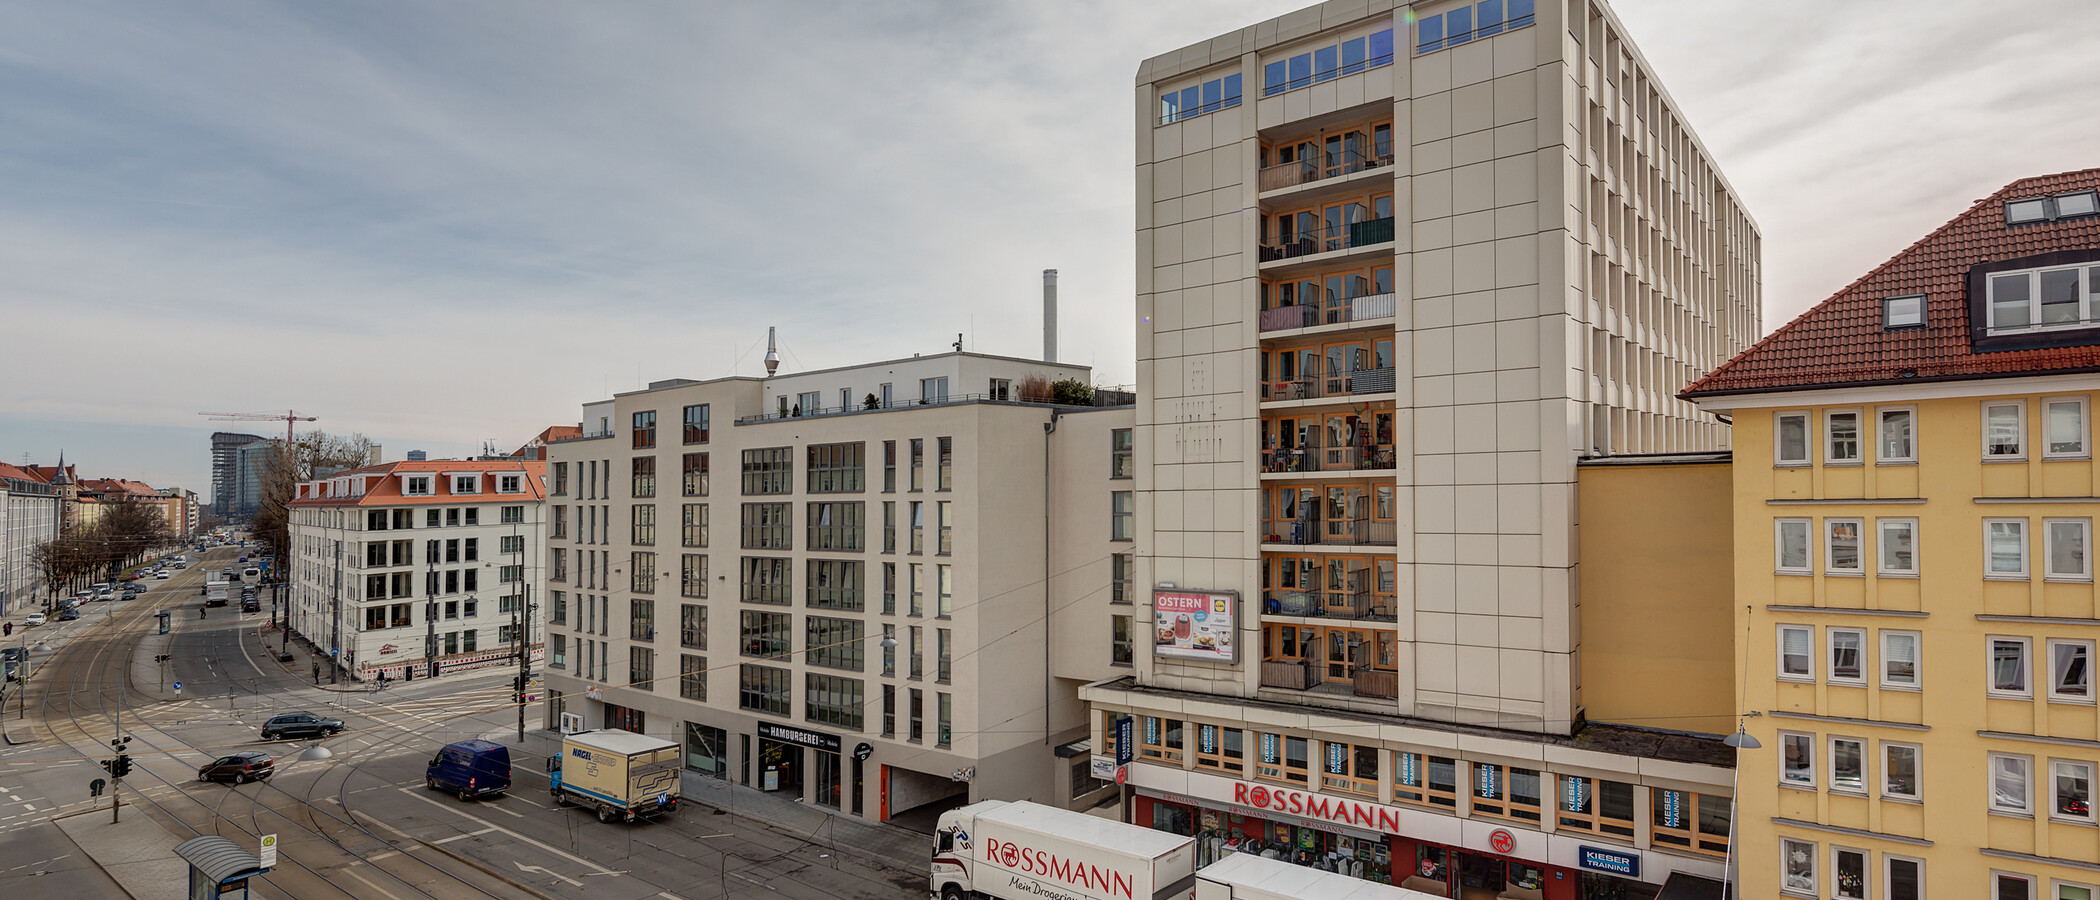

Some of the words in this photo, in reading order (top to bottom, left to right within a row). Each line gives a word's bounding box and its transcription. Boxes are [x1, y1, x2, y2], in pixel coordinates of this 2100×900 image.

[1158, 596, 1202, 609] OSTERN
[770, 726, 819, 745] HAMBURGEREI
[658, 795, 667, 803] W
[1235, 782, 1399, 832] ROSSMANN
[1301, 820, 1344, 835] ROSSMANN
[1586, 851, 1630, 865] KIESER
[986, 837, 1133, 900] ROSSMANN
[1586, 860, 1630, 873] TRAINING
[1009, 876, 1031, 893] Mein
